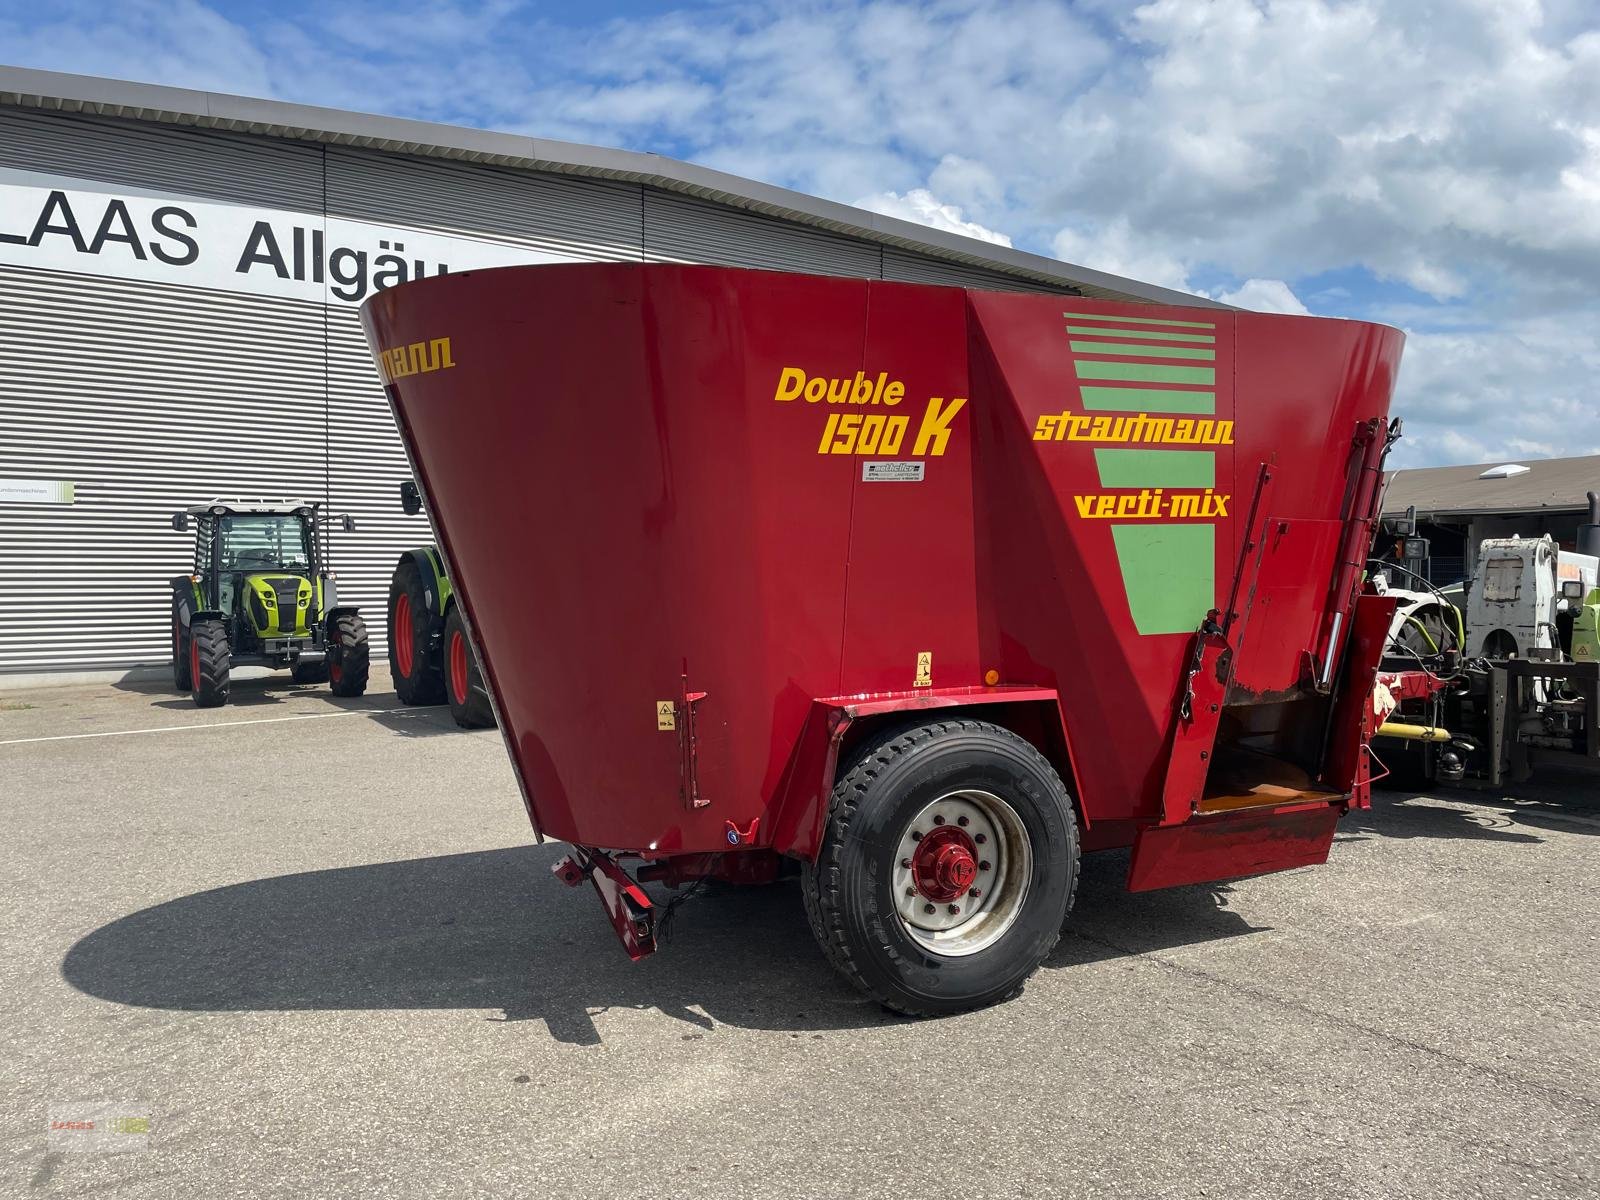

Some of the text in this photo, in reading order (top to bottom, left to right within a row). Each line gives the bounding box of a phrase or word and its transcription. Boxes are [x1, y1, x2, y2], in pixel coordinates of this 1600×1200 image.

[775, 368, 905, 406] Double
[818, 398, 967, 456] 1500 K
[1033, 411, 1235, 445] strautmann
[1074, 489, 1230, 519] verti-mix
